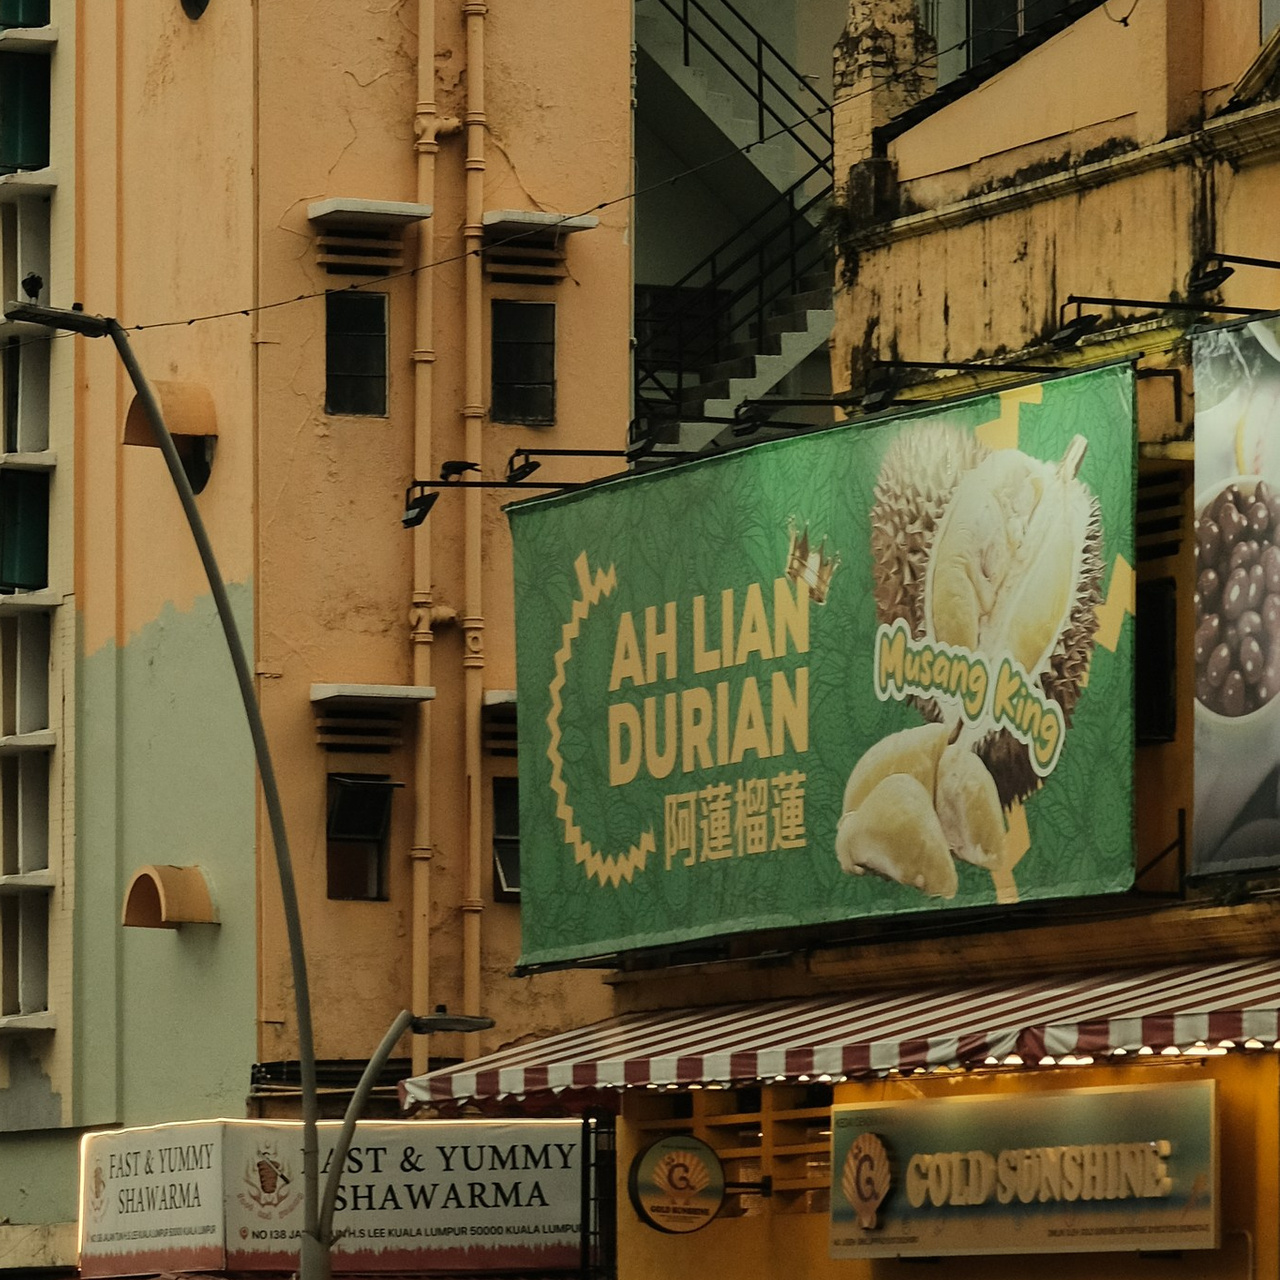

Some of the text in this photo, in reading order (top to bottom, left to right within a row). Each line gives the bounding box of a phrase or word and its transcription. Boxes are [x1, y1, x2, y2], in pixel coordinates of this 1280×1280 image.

[609, 577, 810, 691] AH LIAN
[879, 626, 1060, 769] Musang King
[609, 667, 809, 786] DURIAN
[664, 770, 806, 870] 阿蓮榴蓮
[109, 1143, 214, 1179] FAST & YUMMY
[400, 1146, 426, 1172] &
[436, 1143, 577, 1171] YUMMY
[906, 1140, 1172, 1207] GOLD SUNSHINE
[118, 1182, 201, 1214] SHAWARMA
[334, 1181, 550, 1211] SHAWARMA
[252, 1230, 267, 1239] NO
[270, 1230, 286, 1239] 138
[368, 1228, 385, 1238] LEE
[387, 1227, 422, 1237] KUALA
[424, 1226, 468, 1237] LUMPUR
[470, 1226, 503, 1236] 50000
[506, 1224, 540, 1235] KUALA
